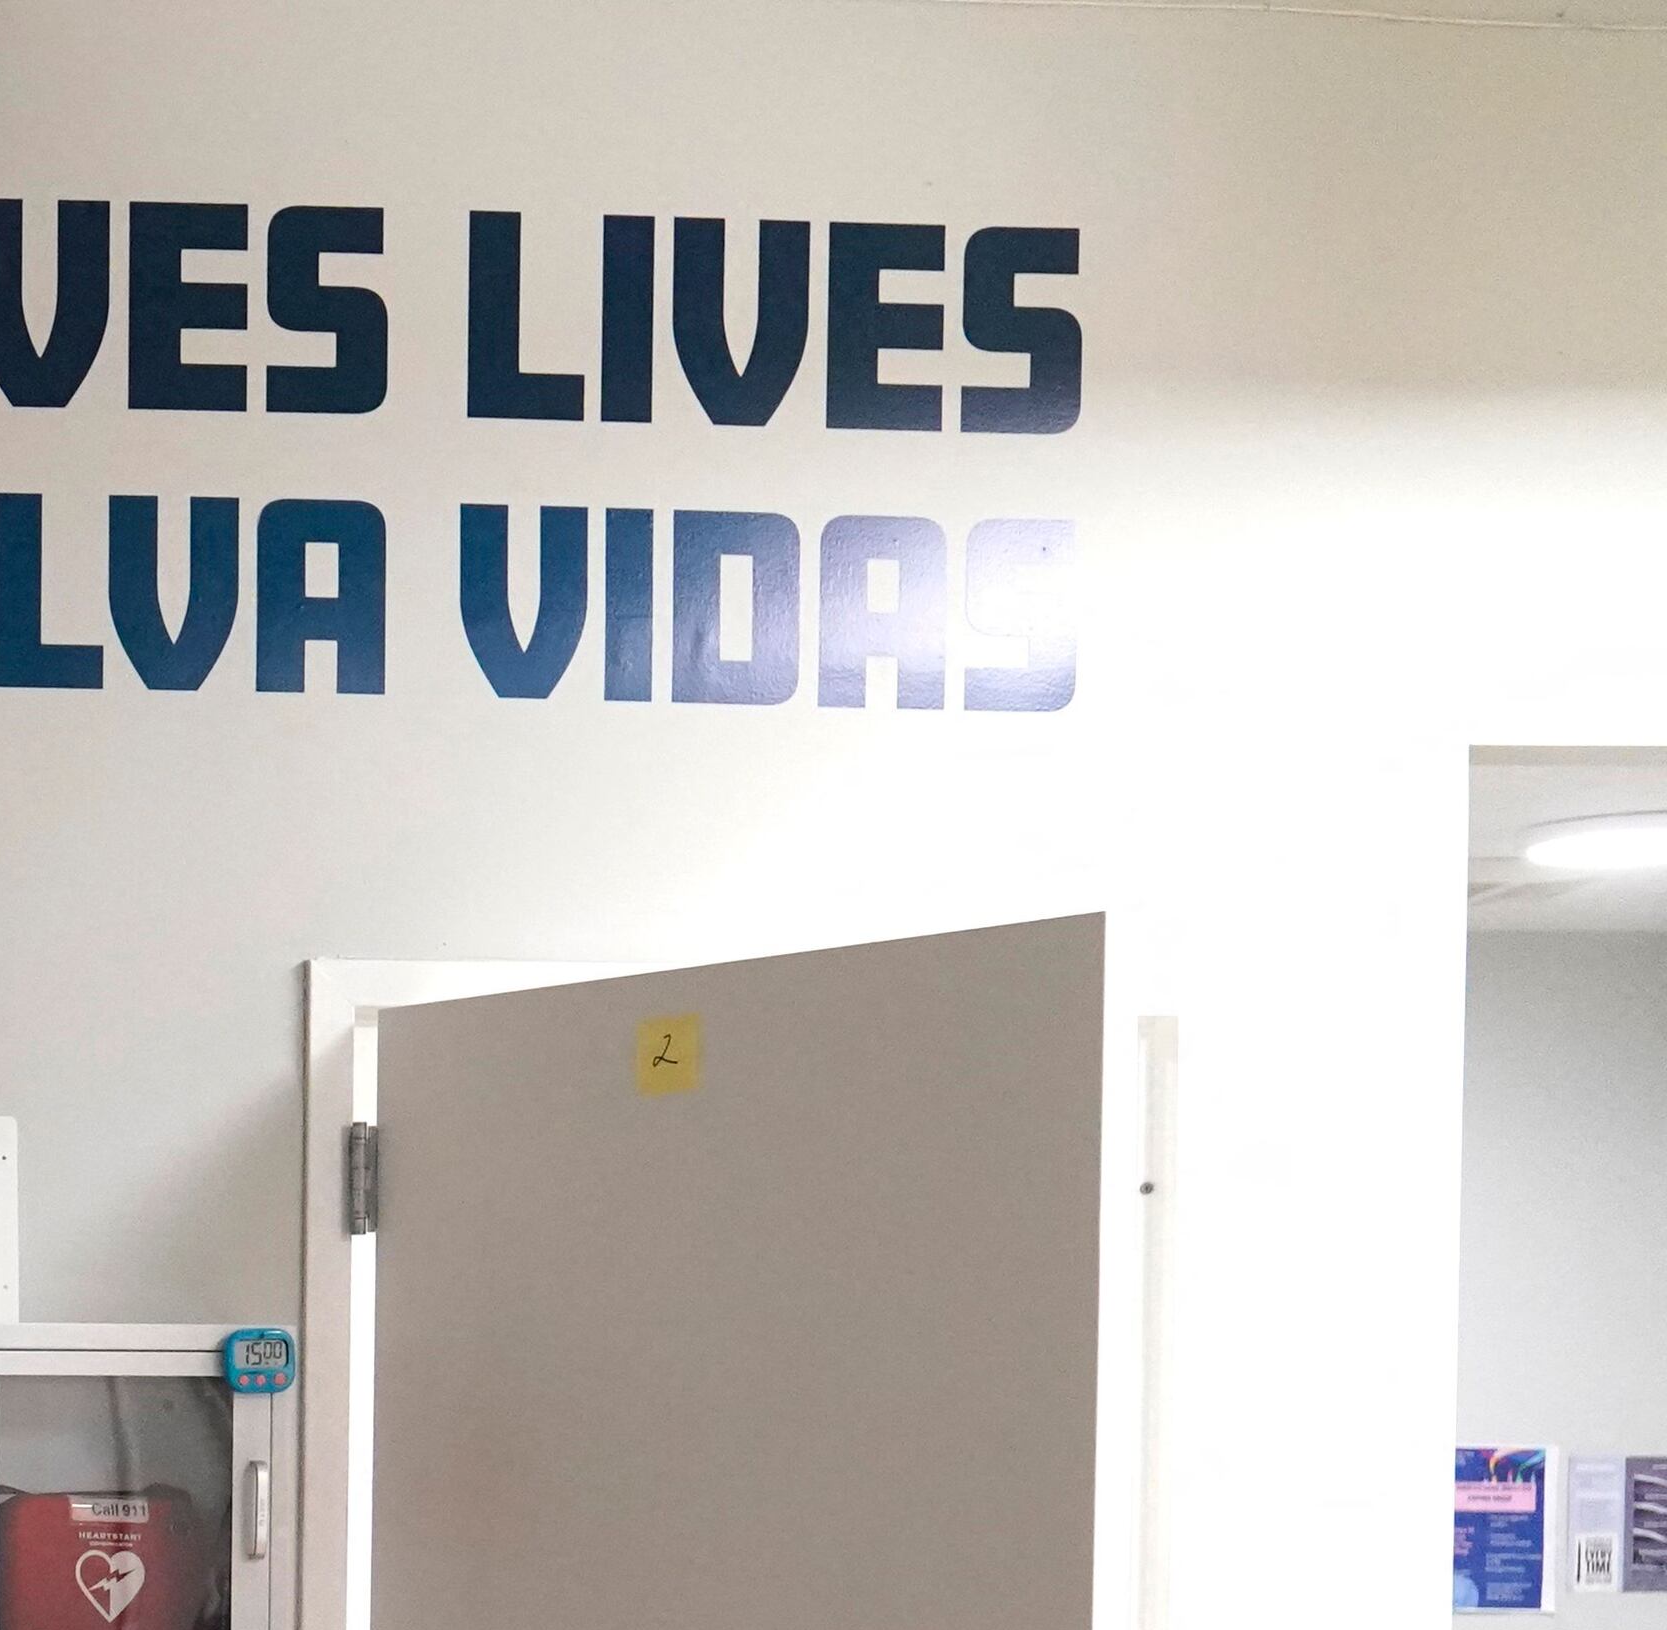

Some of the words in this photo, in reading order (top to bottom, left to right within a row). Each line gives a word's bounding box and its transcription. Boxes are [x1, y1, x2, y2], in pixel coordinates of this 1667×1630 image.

[468, 211, 1081, 433] LIVES
[460, 503, 1077, 711] VIDAS
[652, 1033, 678, 1067] 2
[92, 1503, 119, 1516] Call
[122, 1504, 146, 1516] 911
